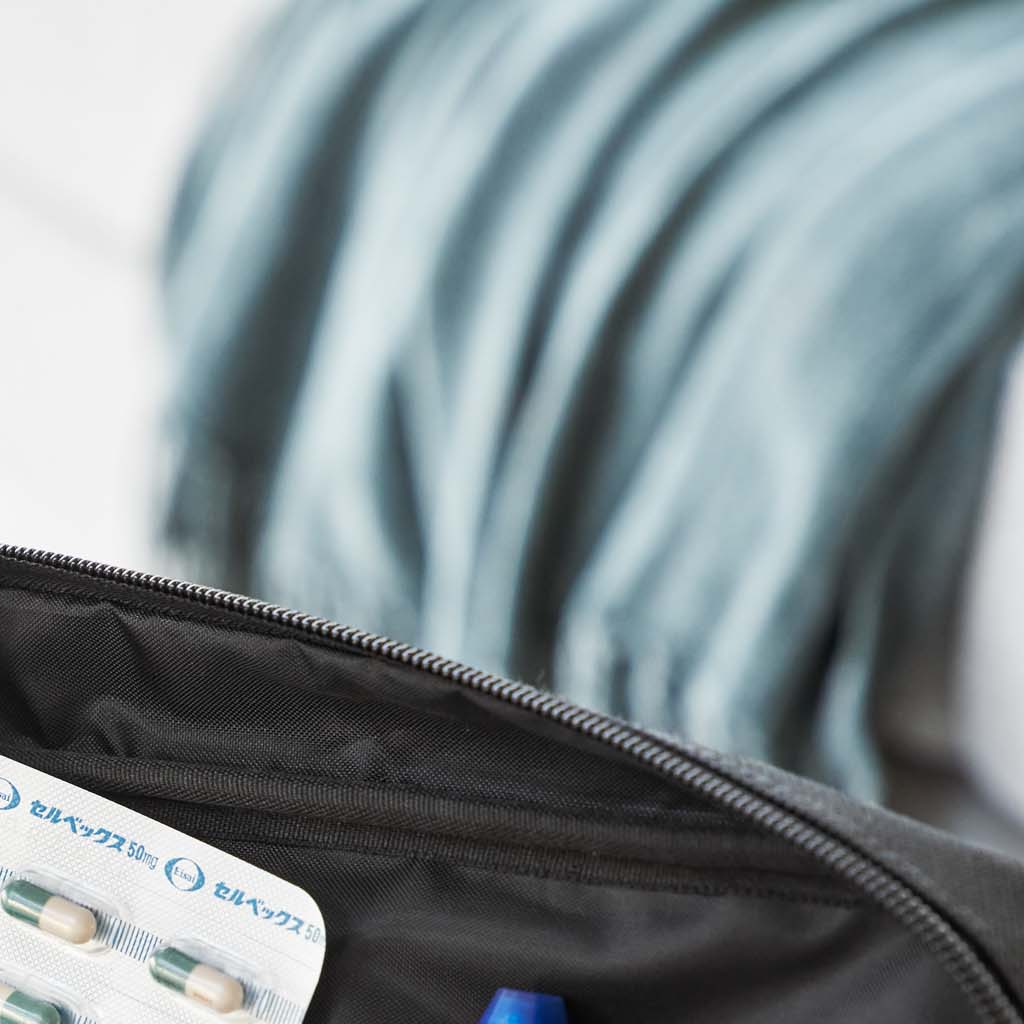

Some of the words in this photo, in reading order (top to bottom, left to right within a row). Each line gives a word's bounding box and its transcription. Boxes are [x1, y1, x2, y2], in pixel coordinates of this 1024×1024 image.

[30, 800, 127, 852] セルベックス
[127, 842, 159, 870] 50mg
[214, 881, 304, 935] セルベックス
[305, 924, 325, 946] 50
